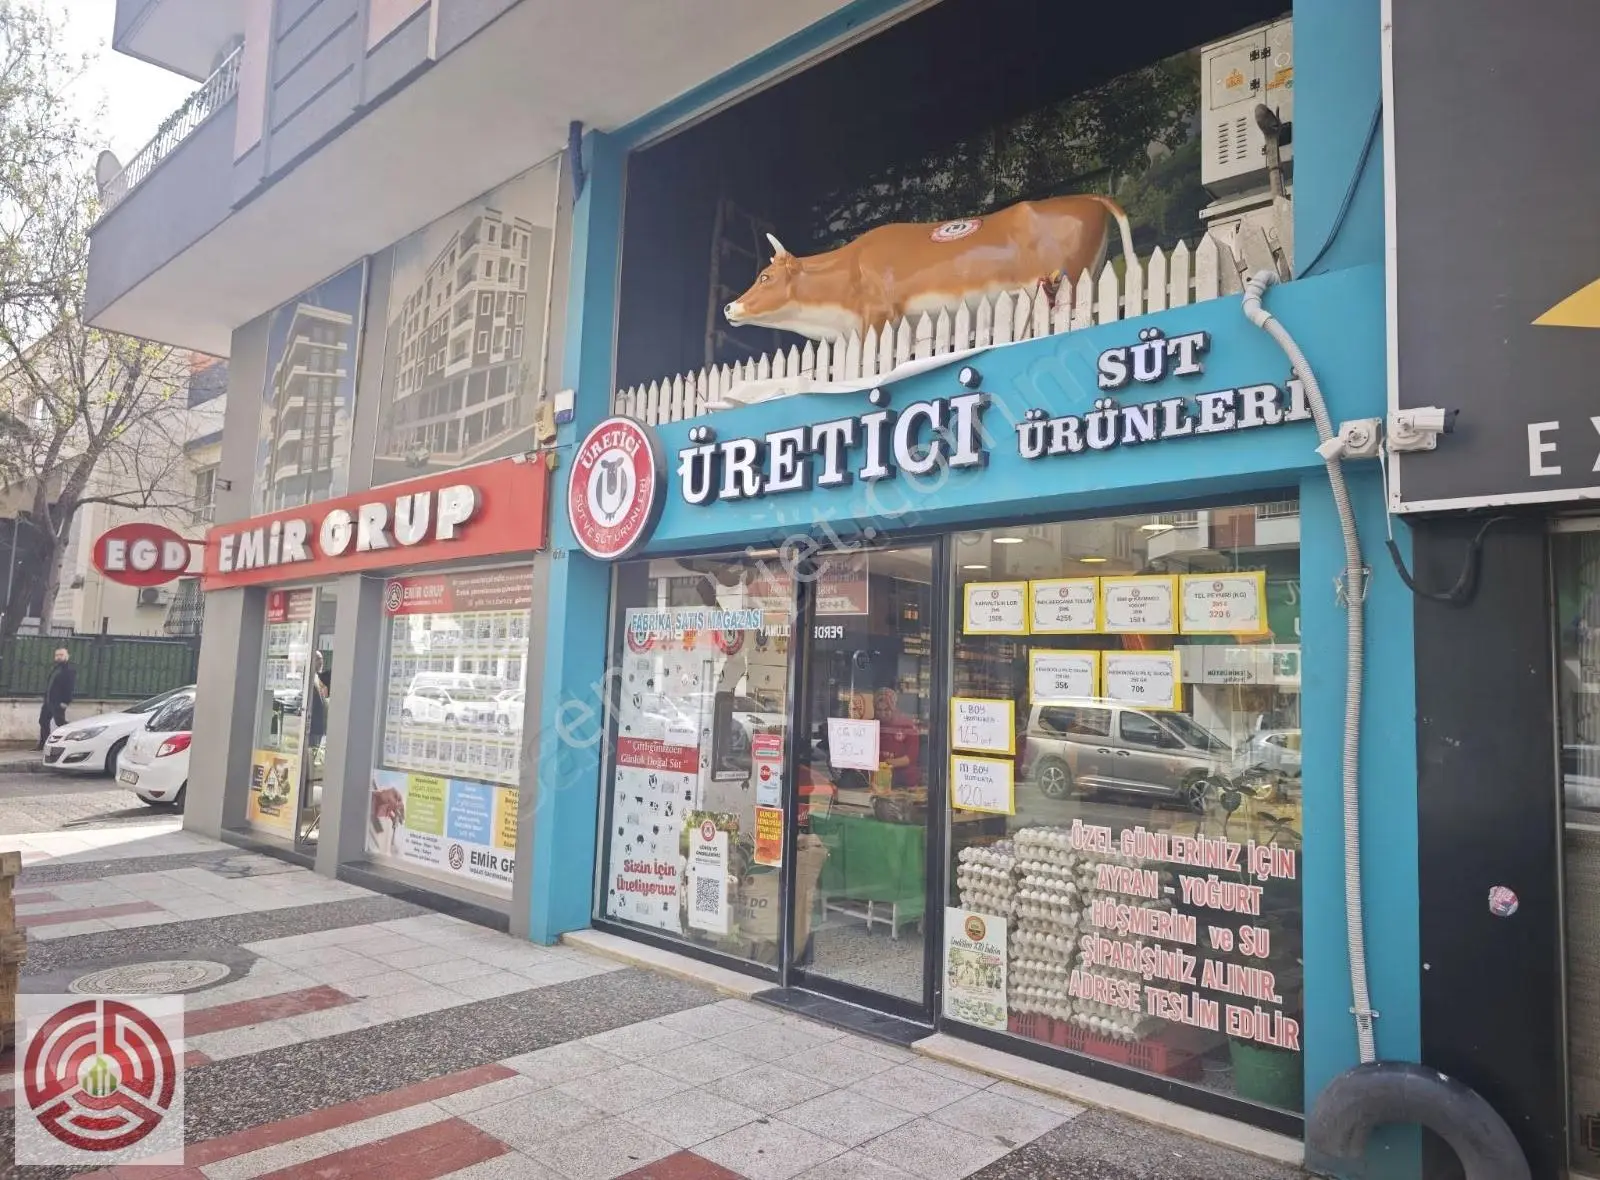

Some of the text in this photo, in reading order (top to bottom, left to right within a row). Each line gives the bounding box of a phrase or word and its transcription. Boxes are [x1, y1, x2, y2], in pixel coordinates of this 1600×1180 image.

[1098, 327, 1211, 391] SÜT
[678, 366, 991, 506] ÜRETİCİ
[1014, 366, 1315, 460] ÜRÜNLERİ
[581, 427, 642, 469] ÜRETİCİ
[218, 484, 482, 573] EMİR GRUP
[104, 539, 190, 572] EGD
[707, 608, 764, 630] MAĞAZASI
[647, 755, 668, 768] Doğal
[470, 850, 497, 870] EMİR
[623, 859, 652, 875] Sizin
[653, 858, 677, 881] İçin
[1071, 818, 1296, 881] ÖZEL GÜNLERİNİZ İÇİN
[616, 873, 677, 897] Üretiyoruz
[1096, 863, 1159, 900] AYRAN
[1178, 874, 1264, 916] YOĞURT
[1091, 897, 1270, 959] HÖŞMERİM ve SU
[1201, 958, 1283, 1004] ALINIR.
[1068, 969, 1301, 1051] ADRESE TESLİM EDİLİR
